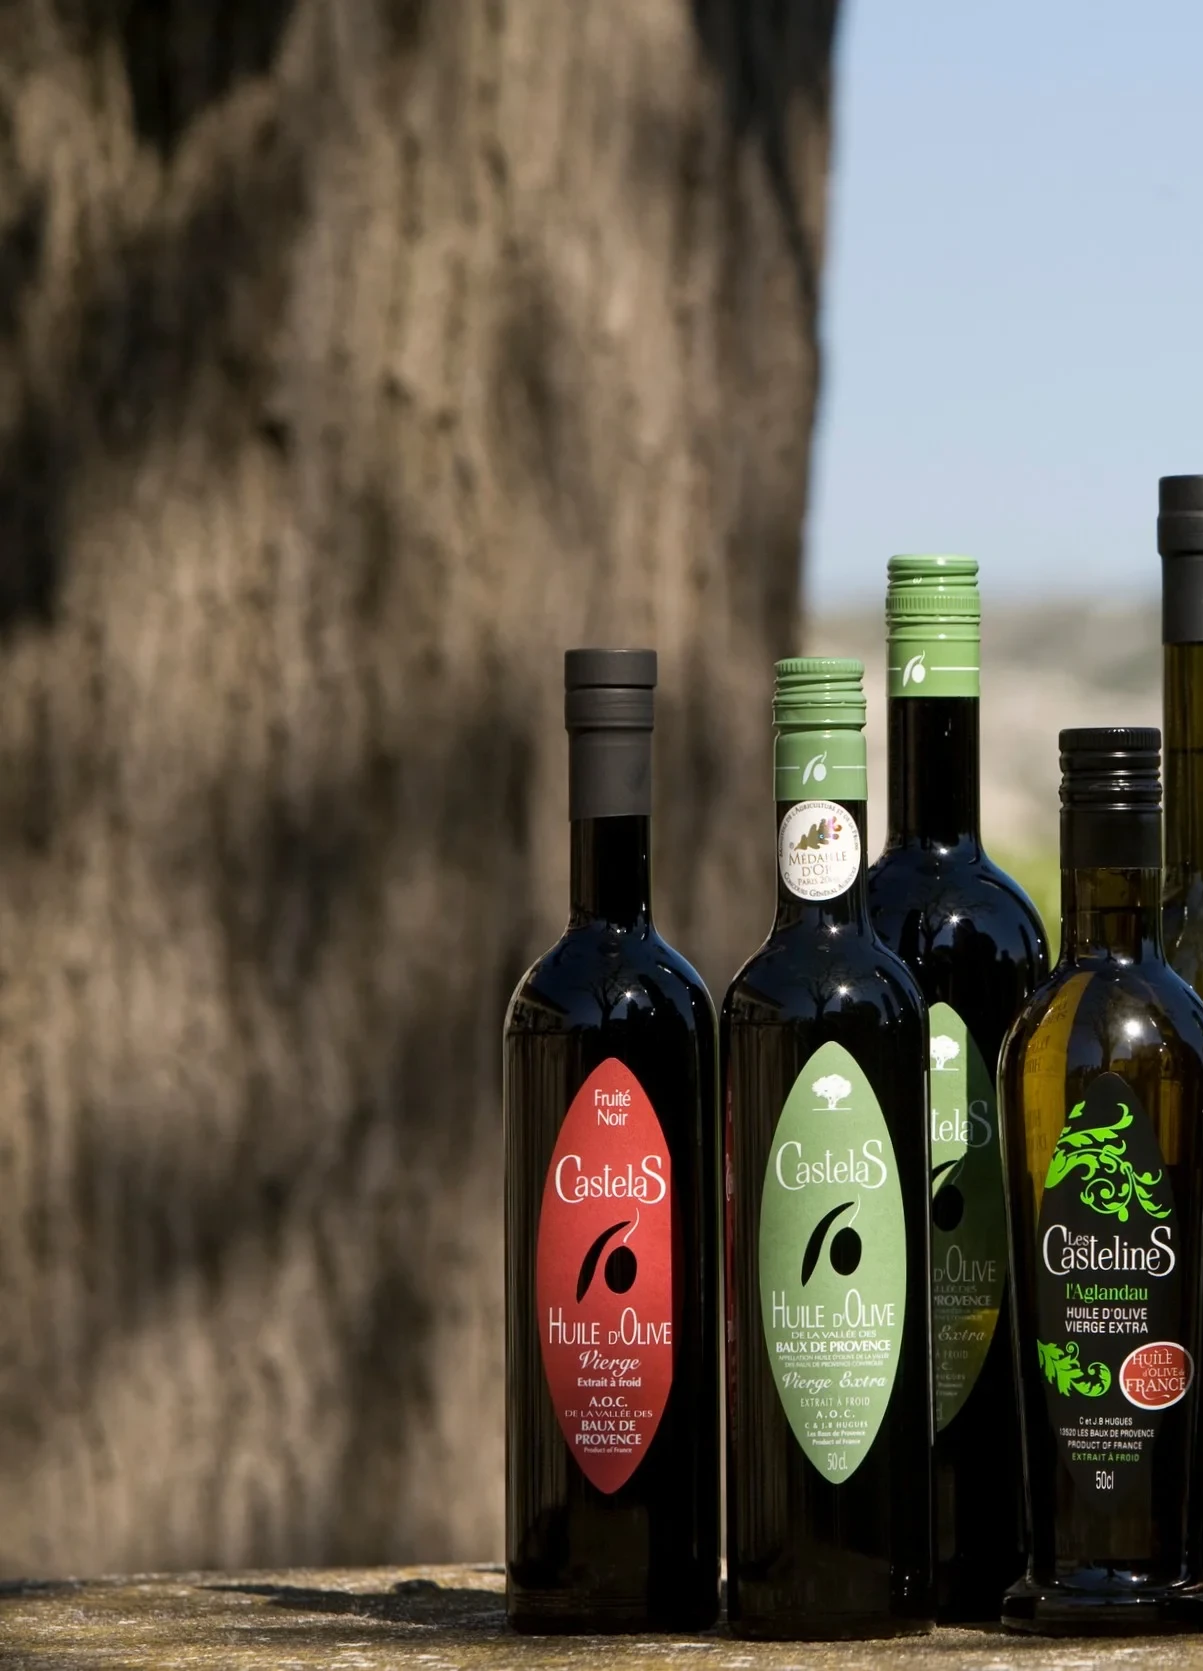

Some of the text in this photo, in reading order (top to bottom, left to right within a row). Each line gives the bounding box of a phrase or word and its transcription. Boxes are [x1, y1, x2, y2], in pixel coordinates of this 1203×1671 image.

[594, 1089, 631, 1107] Fruité
[597, 1109, 628, 1126] Noir
[932, 1100, 992, 1148] telaS
[1068, 1231, 1090, 1246] Les
[1066, 1283, 1148, 1304] l'Aglandau
[772, 1289, 896, 1328] HUILE D'OLIVE
[1066, 1306, 1148, 1320] HUILE D'OLIVE
[550, 1306, 672, 1345] HUILE D'OLIVE
[1065, 1320, 1149, 1334] VIERGE EXTRA
[822, 1330, 856, 1338] VALLÉE
[859, 1330, 876, 1338] DES
[938, 1324, 986, 1342] Extra
[776, 1339, 892, 1352] BAUX DE PROVENCE
[578, 1350, 640, 1378] Vierge
[578, 1377, 642, 1388] Extrait à froid
[782, 1371, 888, 1394] Vierge Extra
[1125, 1377, 1186, 1398] FRANCE
[588, 1396, 628, 1408] A.O.C.
[800, 1398, 833, 1408] EXTRAIT
[846, 1396, 870, 1406] FROID
[595, 1408, 631, 1418] VALLÉE
[634, 1410, 652, 1418] DES
[581, 1420, 636, 1432] BAUX DE
[1104, 1417, 1133, 1426] HUGUES
[576, 1434, 642, 1445] PROVENCE
[1078, 1428, 1089, 1438] LES
[1090, 1429, 1108, 1438] BAUX
[1110, 1429, 1119, 1438] DE
[1120, 1429, 1154, 1438] PROVENCE
[1068, 1440, 1142, 1450] PRODUCT OF FRANCE
[1072, 1452, 1106, 1461] EXTRAIT
[1116, 1453, 1140, 1462] FROID
[1096, 1471, 1114, 1490] 50cl
